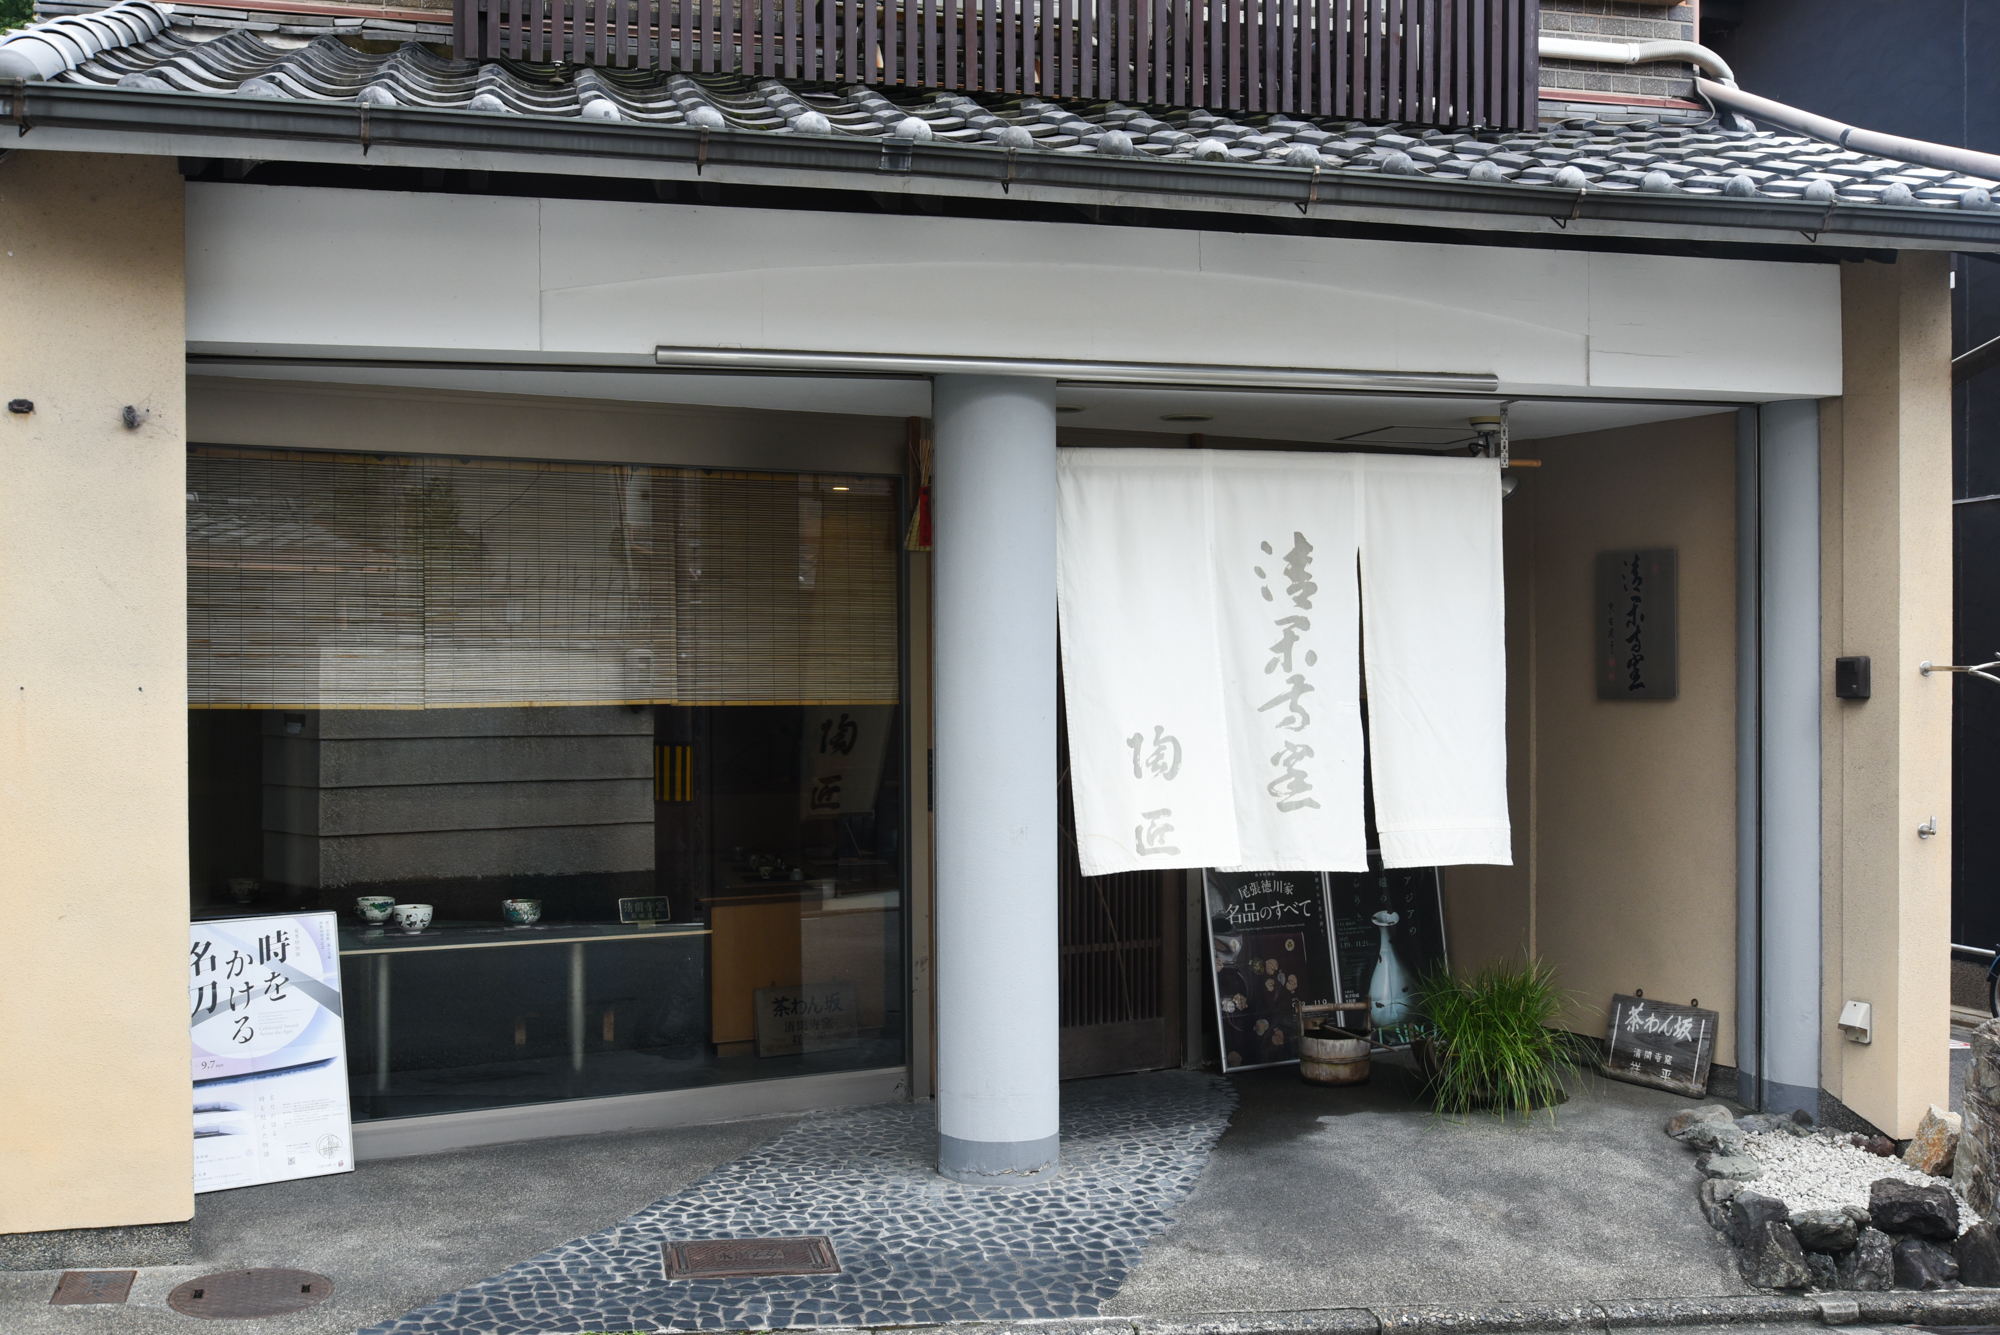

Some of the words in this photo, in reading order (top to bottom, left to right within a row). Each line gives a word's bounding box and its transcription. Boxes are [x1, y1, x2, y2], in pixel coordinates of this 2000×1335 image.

[810, 713, 858, 811] 陶匠
[1126, 725, 1182, 857] 陶匠
[1225, 899, 1312, 925] 名品のすべて
[1237, 879, 1295, 900] 尾張徳川家
[191, 940, 218, 1018] 名刀
[257, 929, 290, 1002] 時を
[225, 950, 255, 1045] かける
[772, 993, 843, 1018] 茶わん坂
[1625, 1002, 1693, 1042] 茶わん坂
[201, 1060, 215, 1071] 9.7
